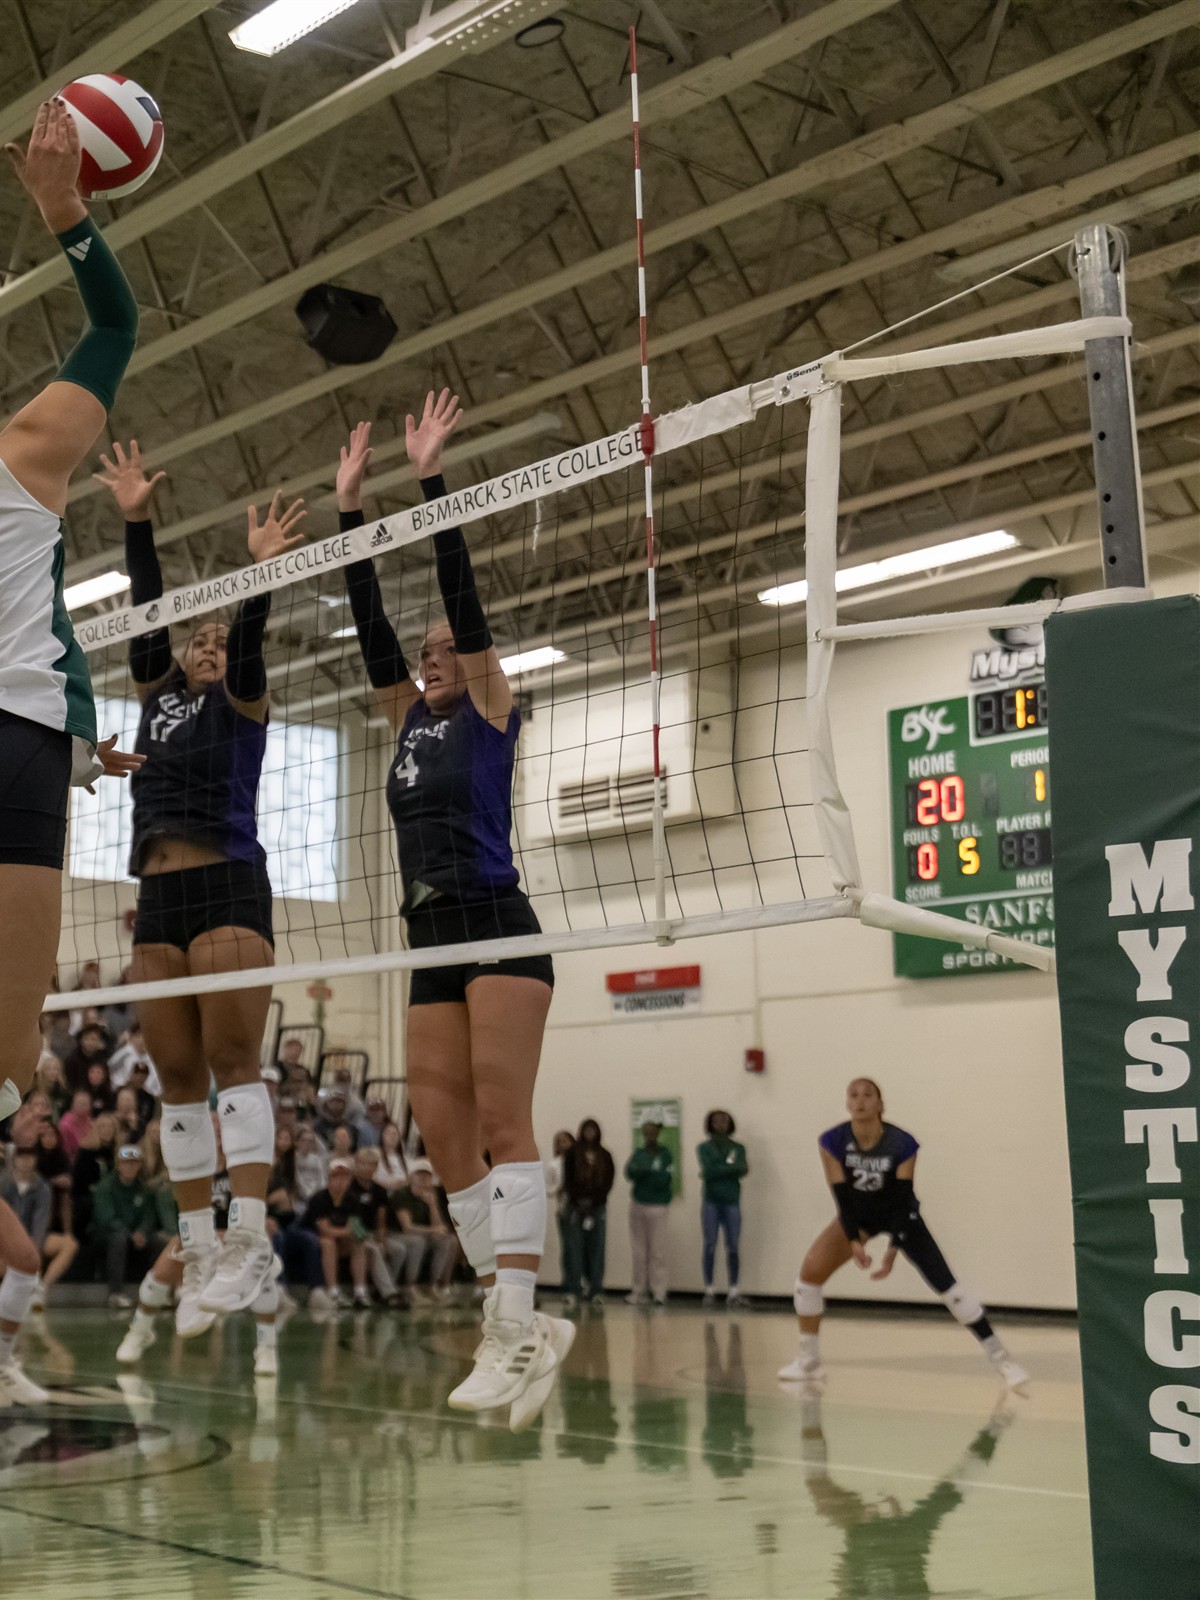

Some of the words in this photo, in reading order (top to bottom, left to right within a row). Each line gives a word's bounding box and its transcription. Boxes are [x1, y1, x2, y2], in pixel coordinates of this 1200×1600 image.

[412, 482, 497, 531] BISMARCK
[501, 463, 552, 500] STATE
[557, 430, 642, 479] COLLEGE
[370, 534, 393, 548] adidas
[173, 574, 238, 613] BISMARCK
[242, 559, 282, 590] STATE
[285, 536, 351, 574] COLLEGE
[80, 614, 130, 646] COLLEGE
[150, 713, 188, 743] 17
[395, 750, 419, 788] 4
[908, 751, 956, 778] HOME
[917, 775, 965, 826] 20
[1034, 769, 1046, 802] 1
[903, 827, 940, 847] FOULS
[996, 813, 1041, 834] PLAYER
[917, 842, 939, 880] 0
[958, 837, 980, 875] 5
[905, 883, 941, 902] SCORE
[943, 950, 1024, 969] SPOR
[1105, 838, 1200, 1464] MYSTICS
